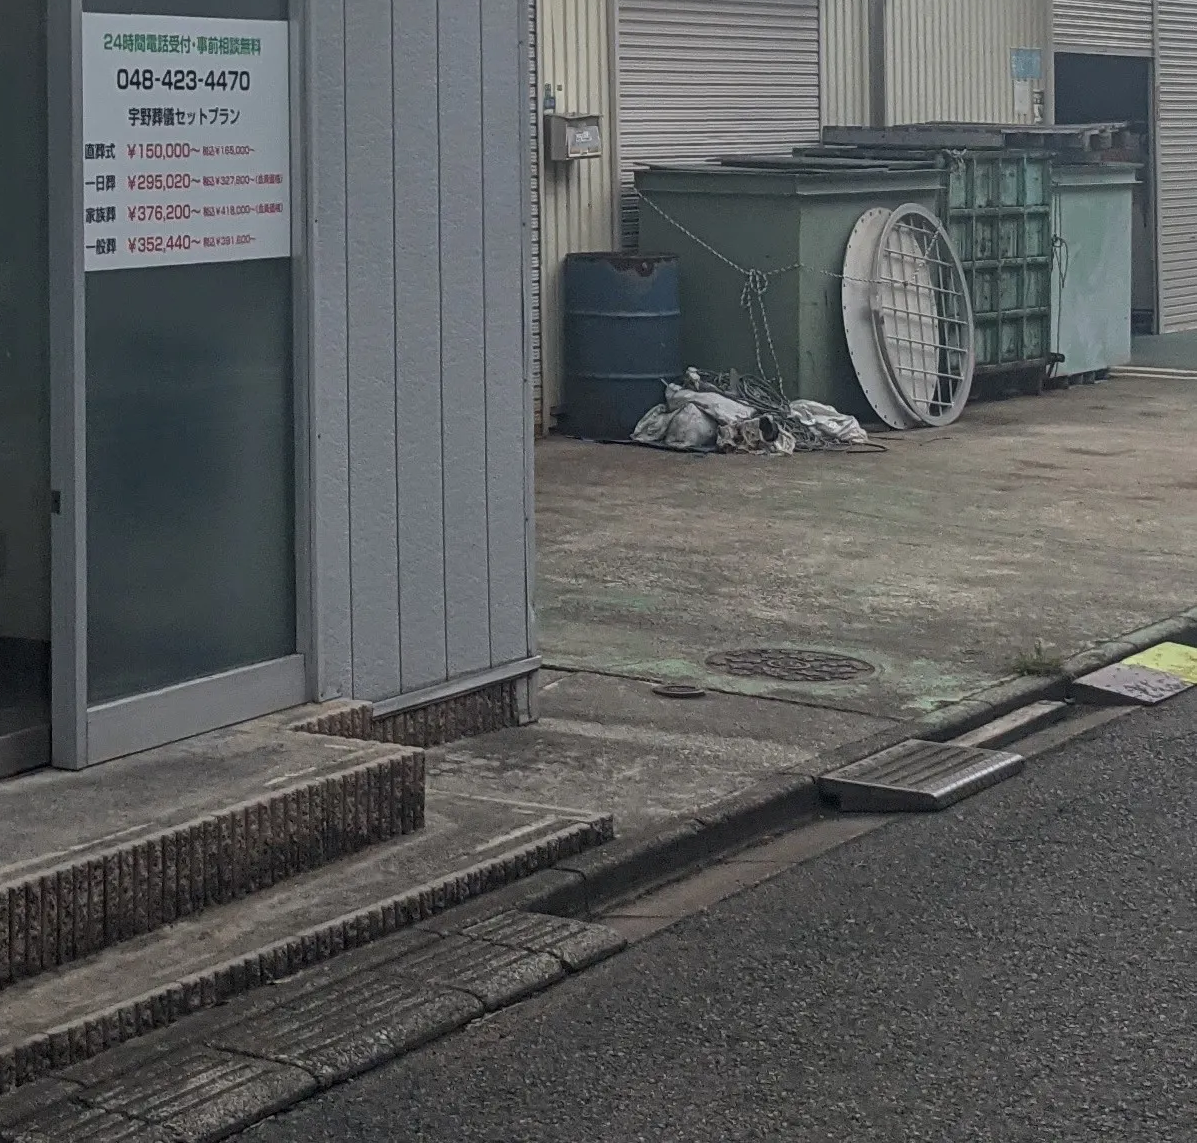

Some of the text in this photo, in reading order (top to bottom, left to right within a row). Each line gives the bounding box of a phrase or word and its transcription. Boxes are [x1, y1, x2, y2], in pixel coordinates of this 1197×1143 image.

[116, 68, 250, 91] 048-423-4470
[128, 107, 241, 127] 宇野葬儀セットプラン
